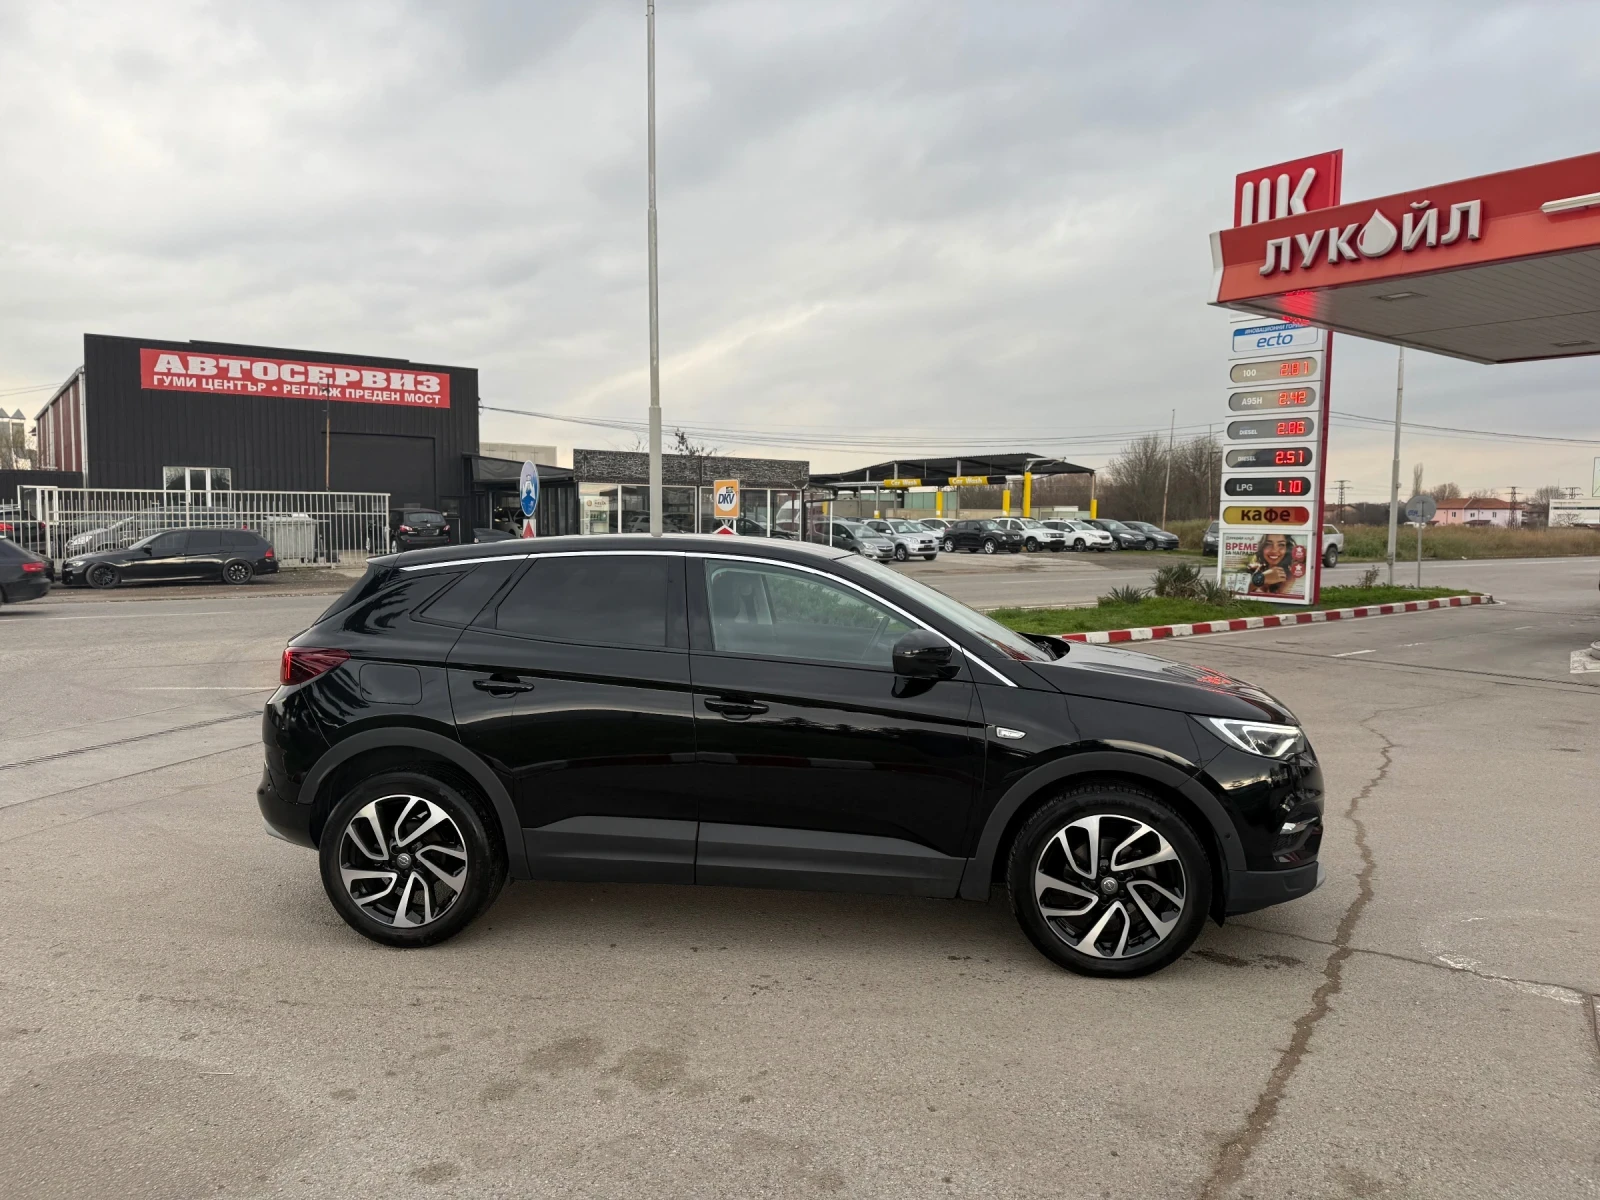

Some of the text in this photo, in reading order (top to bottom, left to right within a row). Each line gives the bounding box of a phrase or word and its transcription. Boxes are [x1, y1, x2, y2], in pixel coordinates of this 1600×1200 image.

[1256, 332, 1294, 348] ecto
[153, 353, 441, 393] АВТОСЕРВИЗ
[1243, 361, 1308, 377] 100 2.81
[153, 375, 441, 404] ГУМИ ЦЕНТЪР РЕГЛАЖ ПРЕДЕН МОСТ
[1279, 390, 1307, 405] 2.42
[1275, 450, 1304, 464] 2.51
[1277, 480, 1302, 493] 1.10
[717, 493, 735, 505] DKV
[1241, 508, 1291, 523] кафе
[1225, 542, 1258, 551] ВРЕМЕ
